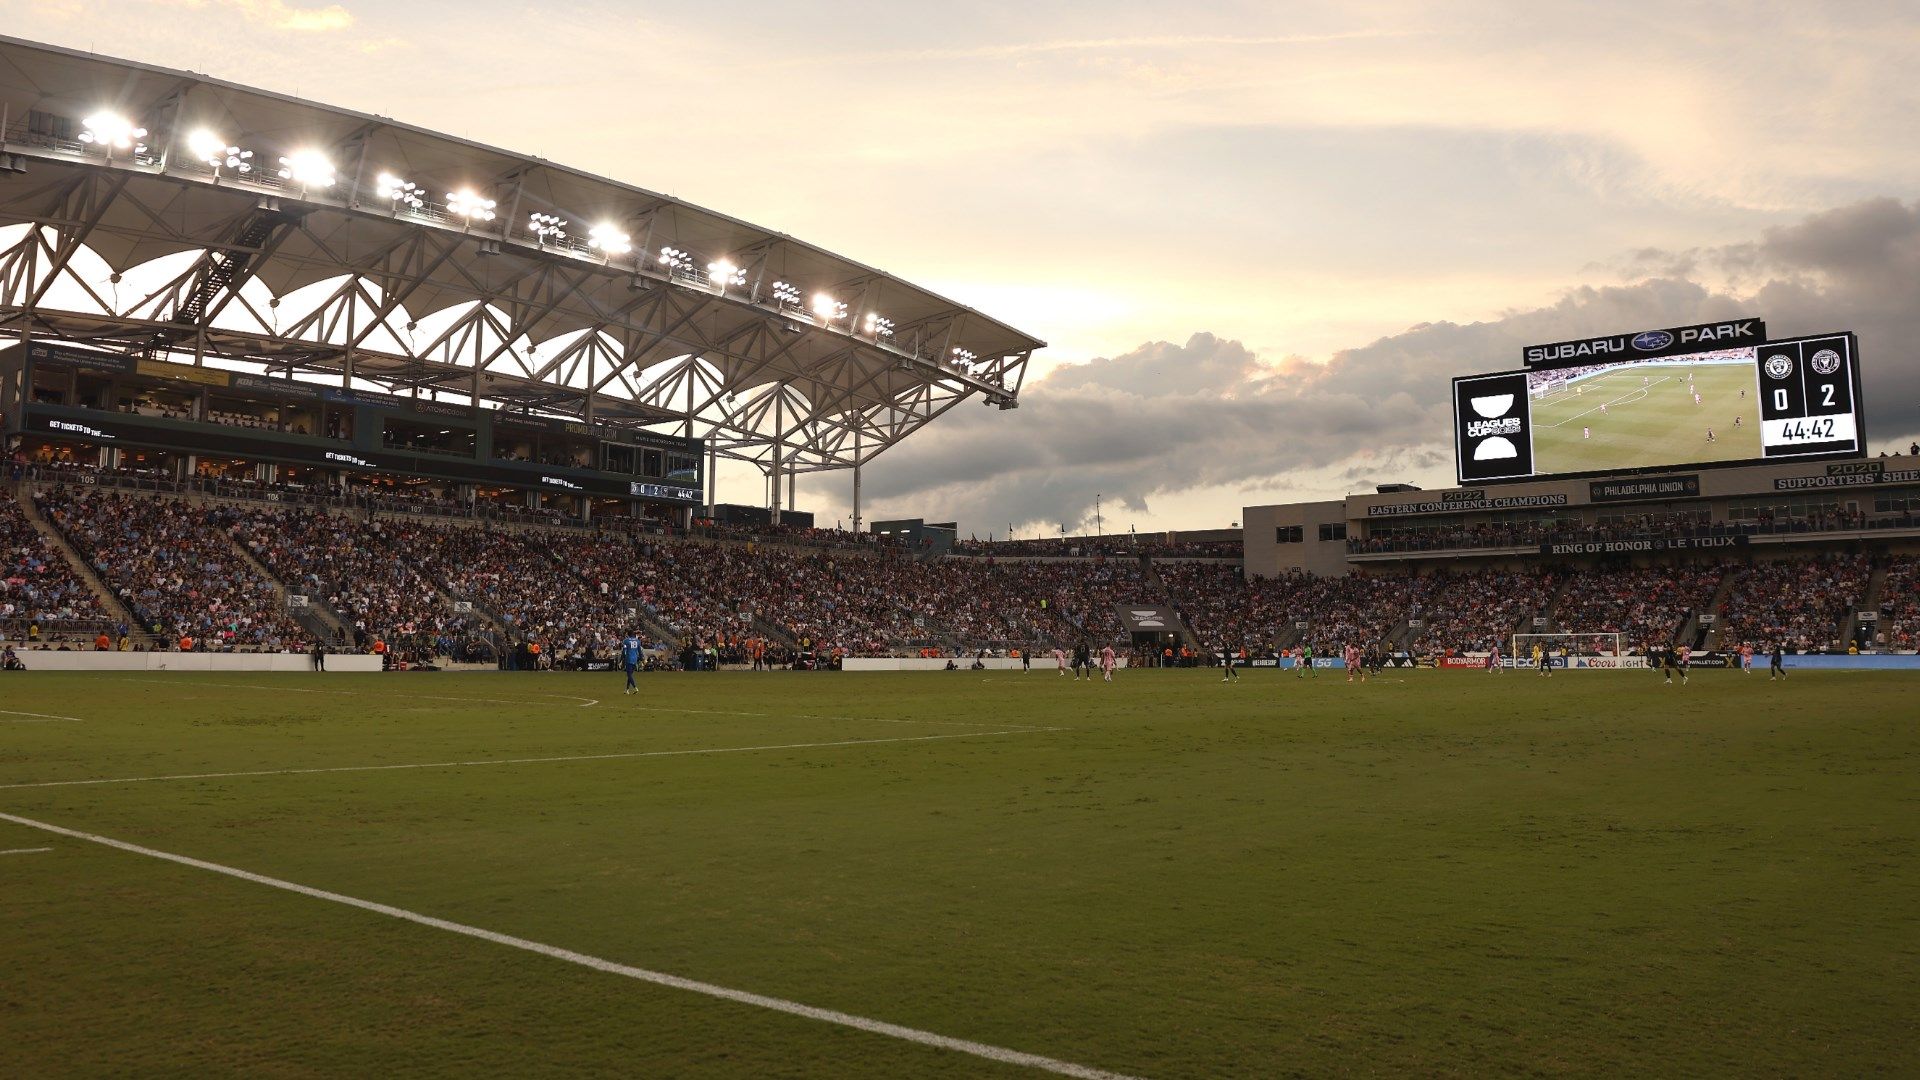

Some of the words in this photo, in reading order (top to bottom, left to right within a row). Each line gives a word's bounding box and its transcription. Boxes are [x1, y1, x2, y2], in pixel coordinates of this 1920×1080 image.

[1528, 338, 1624, 362] SUBARU
[1680, 322, 1754, 344] PARK
[1774, 388, 1788, 411] 0
[1821, 384, 1835, 407] 2
[49, 420, 60, 428] GET
[61, 423, 83, 432] TICKETS
[83, 426, 90, 434] TO
[91, 429, 102, 437] THE
[1467, 418, 1520, 430] LEAGUES
[1782, 419, 1835, 440] 44:42
[1467, 428, 1491, 437] CUP
[1831, 462, 1880, 474] 2020
[81, 476, 95, 484] 105
[1778, 473, 1878, 489] SUPPORTERS'
[640, 484, 645, 494] 0
[654, 486, 658, 495] 2
[1604, 484, 1658, 496] PHILADELPHIA
[1659, 482, 1684, 493] UNION
[1444, 491, 1482, 501] 2022
[411, 505, 422, 513] 107
[1369, 504, 1417, 515] EASTERN
[1419, 500, 1492, 512] CONFERENCE
[1494, 495, 1566, 508] CHAMPIONS
[1552, 543, 1583, 554] RING
[1586, 542, 1603, 553] OF
[1605, 540, 1653, 552] HONOR
[1667, 538, 1686, 549] LE
[1692, 537, 1736, 549] TOUX
[629, 640, 638, 649] 18
[1317, 658, 1332, 667] 5G
[1447, 657, 1486, 665] BODYARMOR
[1588, 657, 1616, 668] Coors
[1620, 660, 1643, 668] IGHT
